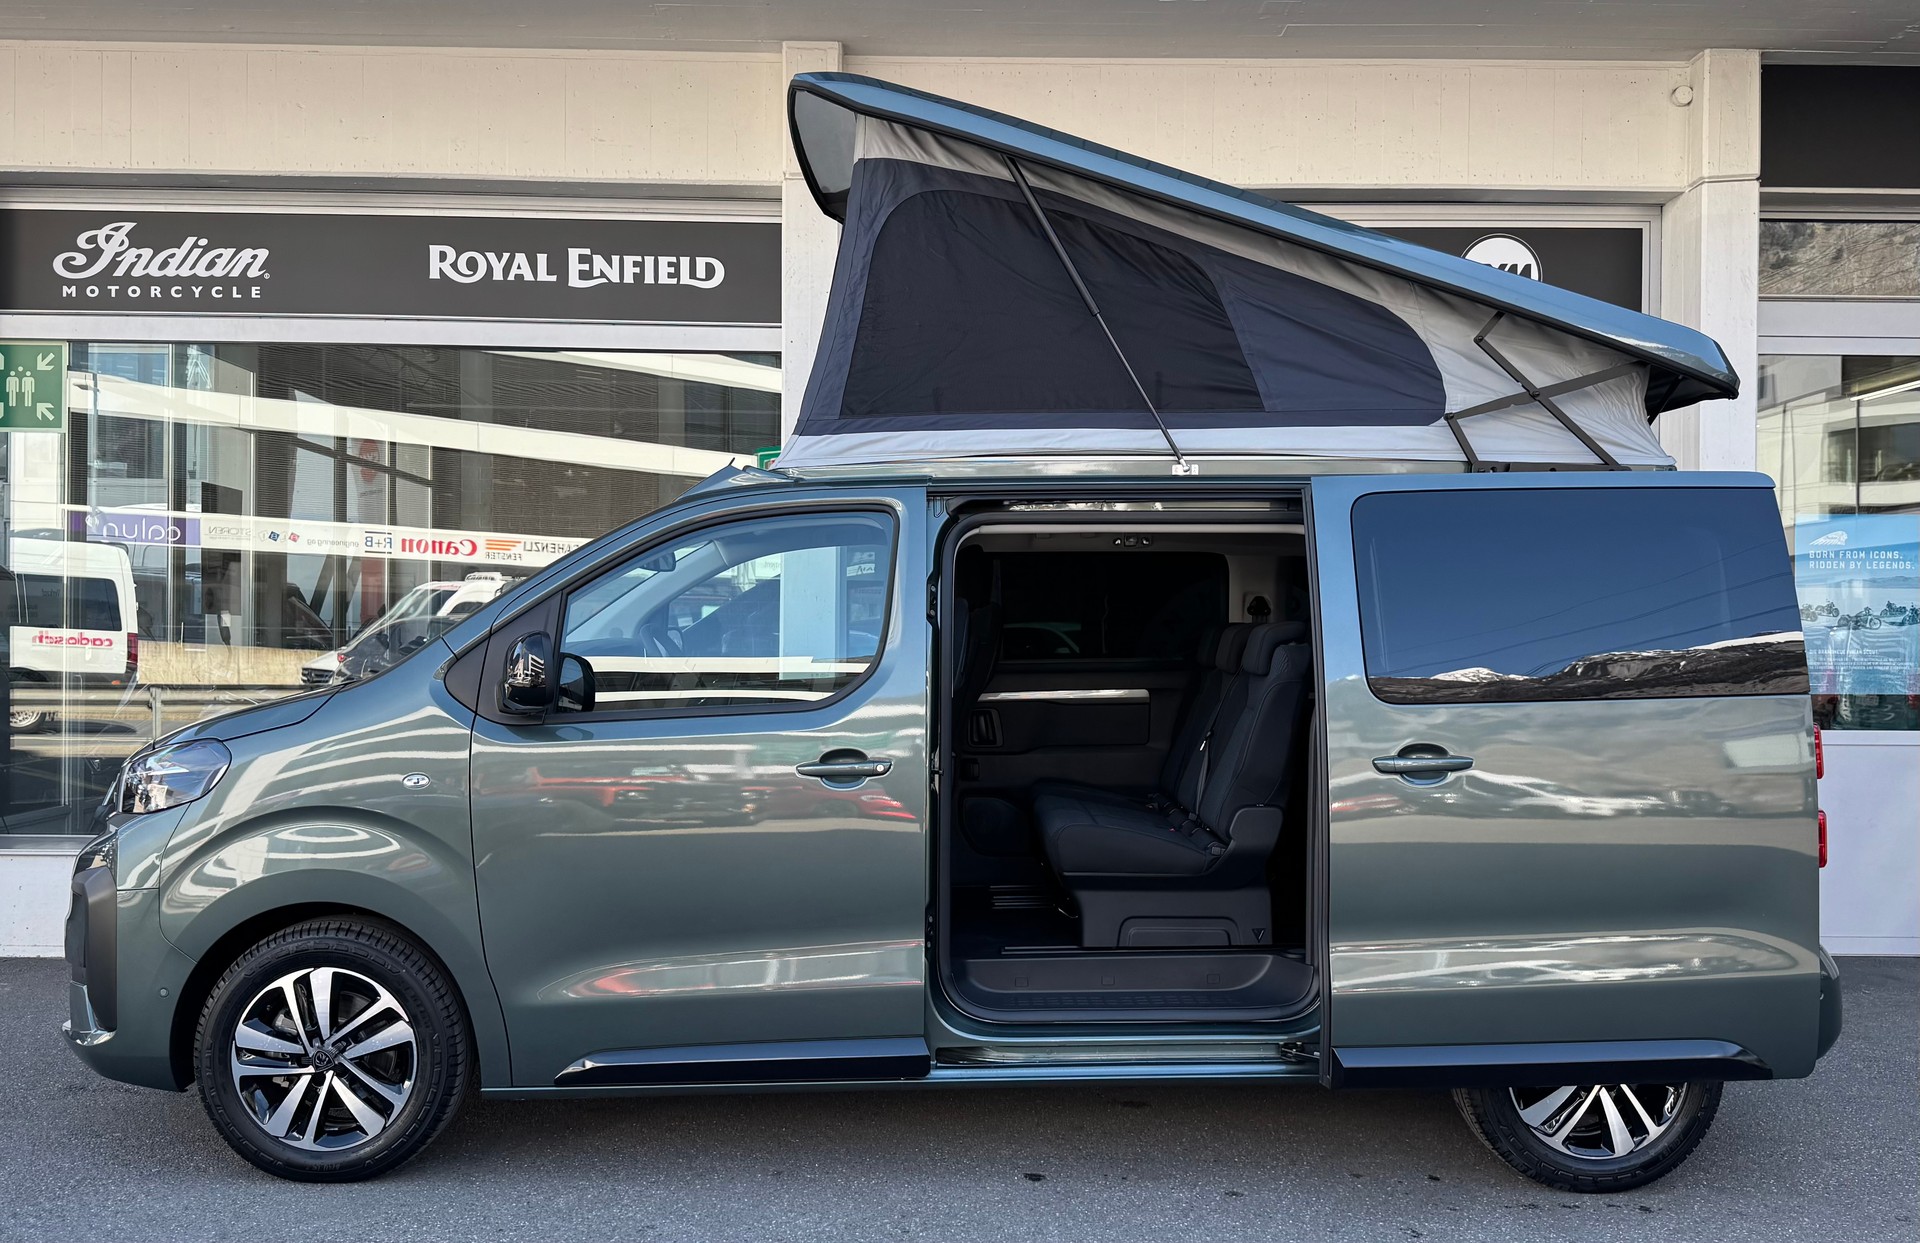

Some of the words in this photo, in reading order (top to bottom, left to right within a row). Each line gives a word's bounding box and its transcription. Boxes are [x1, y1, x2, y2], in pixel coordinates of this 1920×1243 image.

[52, 221, 270, 279] Indian
[429, 244, 557, 284] ROYAL
[567, 247, 726, 289] ENFIELD
[62, 285, 261, 299] MOTORCYCLE
[1809, 550, 1835, 559] BORN
[1839, 551, 1866, 559] FROM
[1870, 551, 1904, 560] ICONS.
[1809, 561, 1845, 569] RIDDEN
[1850, 561, 1862, 569] BY
[1866, 561, 1916, 570] LEGENDS.
